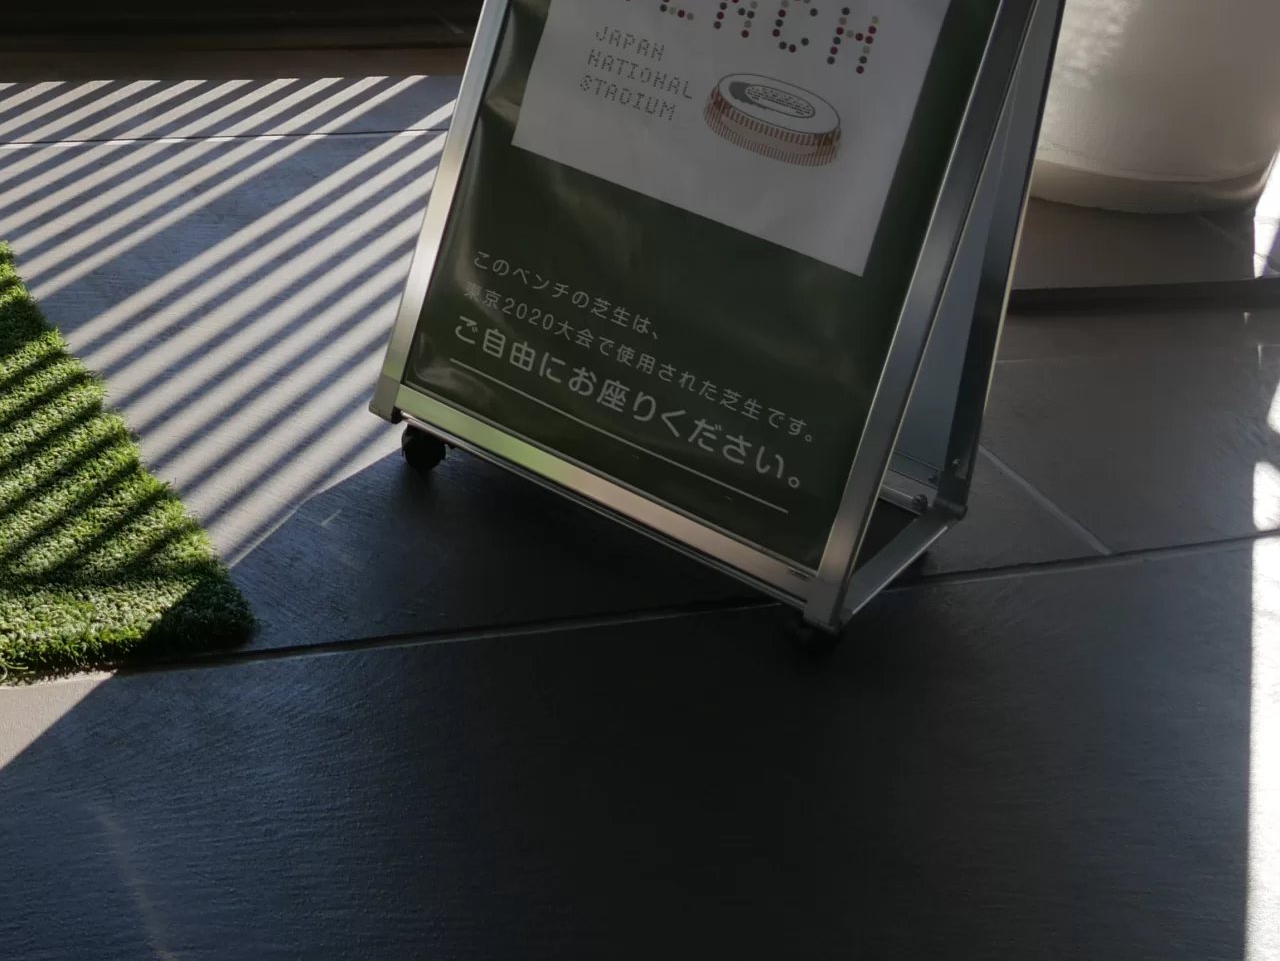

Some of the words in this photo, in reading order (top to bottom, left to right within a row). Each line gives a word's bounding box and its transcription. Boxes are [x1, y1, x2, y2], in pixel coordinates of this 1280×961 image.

[587, 49, 692, 100] NATIONAL
[595, 26, 665, 61] JAPAN
[579, 74, 676, 121] STADIUM
[472, 250, 659, 340] このベンチの芝生は、
[463, 281, 814, 443] 東京2020大会で使用された芝生です。
[454, 314, 801, 489] ご自由にお座りください。
